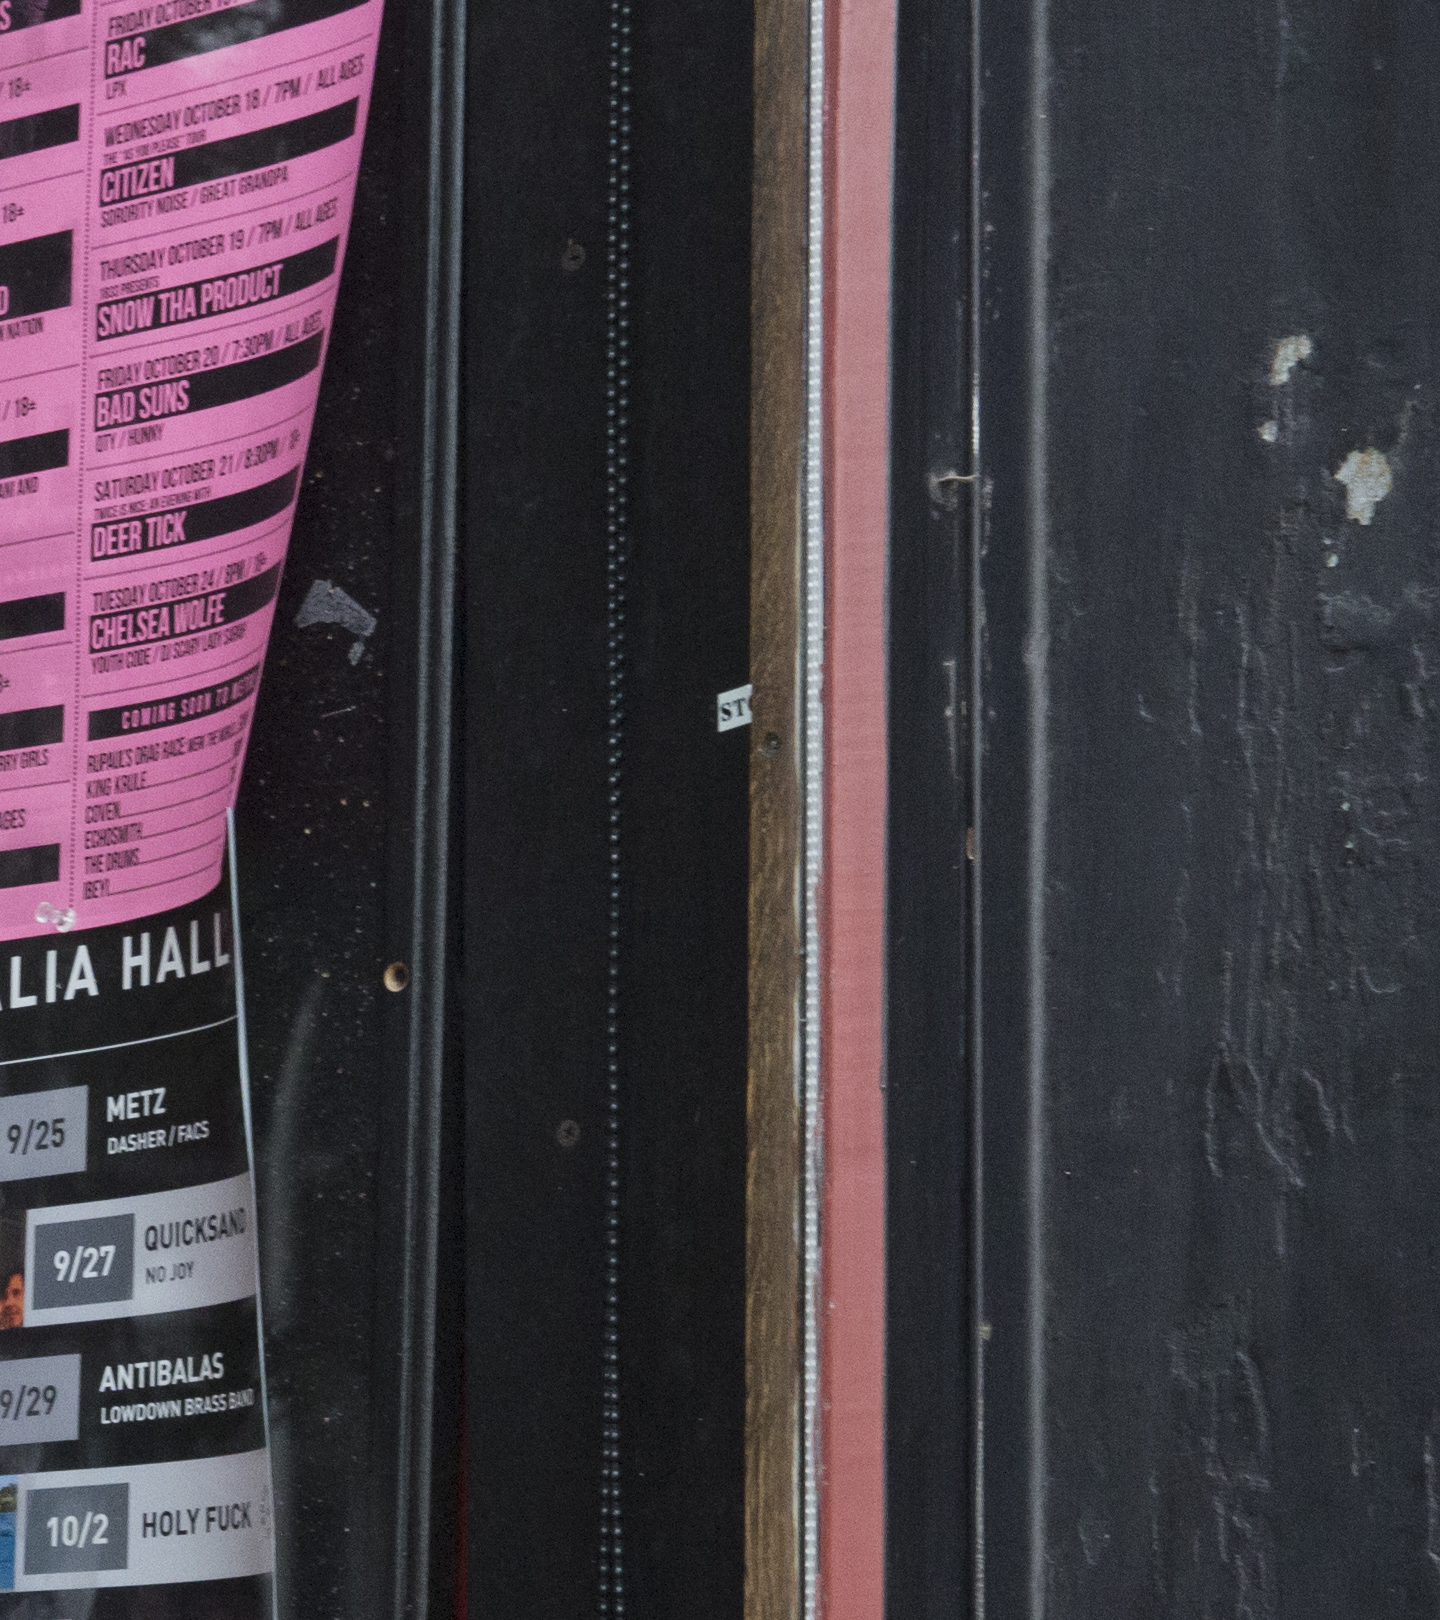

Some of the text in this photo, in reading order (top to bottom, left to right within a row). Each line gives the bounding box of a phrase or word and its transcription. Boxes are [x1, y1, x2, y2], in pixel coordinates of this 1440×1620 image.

[108, 8, 151, 37] FRIDAY
[107, 36, 147, 76] RAC
[104, 108, 180, 147] WEDNESDAY
[183, 94, 241, 127] OCTOBER
[274, 76, 302, 104] 7PM
[315, 65, 336, 91] ALL
[339, 53, 366, 81] AGES
[101, 157, 176, 203] CITIZEN
[156, 191, 189, 216] NOISE
[199, 179, 236, 204] GREAT
[100, 247, 166, 281] THURSDAY
[168, 234, 225, 266] OCTOBER
[97, 263, 284, 338] SNOW THA PRODUCT
[97, 359, 144, 391] FRIDAY
[144, 349, 201, 380] OCTOBER
[96, 379, 191, 428] BAD SUNS
[95, 471, 160, 502] SATURDAY
[162, 459, 217, 489] OCTOBER
[93, 510, 188, 558] DEER TICK
[93, 582, 148, 613] TUESDAY
[149, 573, 200, 602] OCTOBER
[91, 592, 227, 650] CHELSEA WOLFE
[120, 701, 177, 731] COMING
[180, 692, 213, 718] SOON
[721, 697, 745, 721] ST
[19, 748, 50, 770] GIRLS
[86, 769, 148, 799] KING KRULE
[85, 801, 121, 824] COVEN
[84, 821, 143, 849] ECHOSMITH
[84, 853, 105, 875] THE
[120, 911, 231, 992] HALL
[6, 1086, 168, 1156] 9/25 METZ
[52, 1206, 249, 1283] 9/27 QUICKSAND
[145, 1260, 195, 1285] NO JOY
[98, 1352, 226, 1393] ANTIBALAS
[100, 1399, 182, 1425] LOWDOWN
[184, 1392, 228, 1416] BRASS
[44, 1512, 110, 1549] 10/2
[141, 1507, 200, 1539] HOLY
[205, 1501, 253, 1534] FUCK
